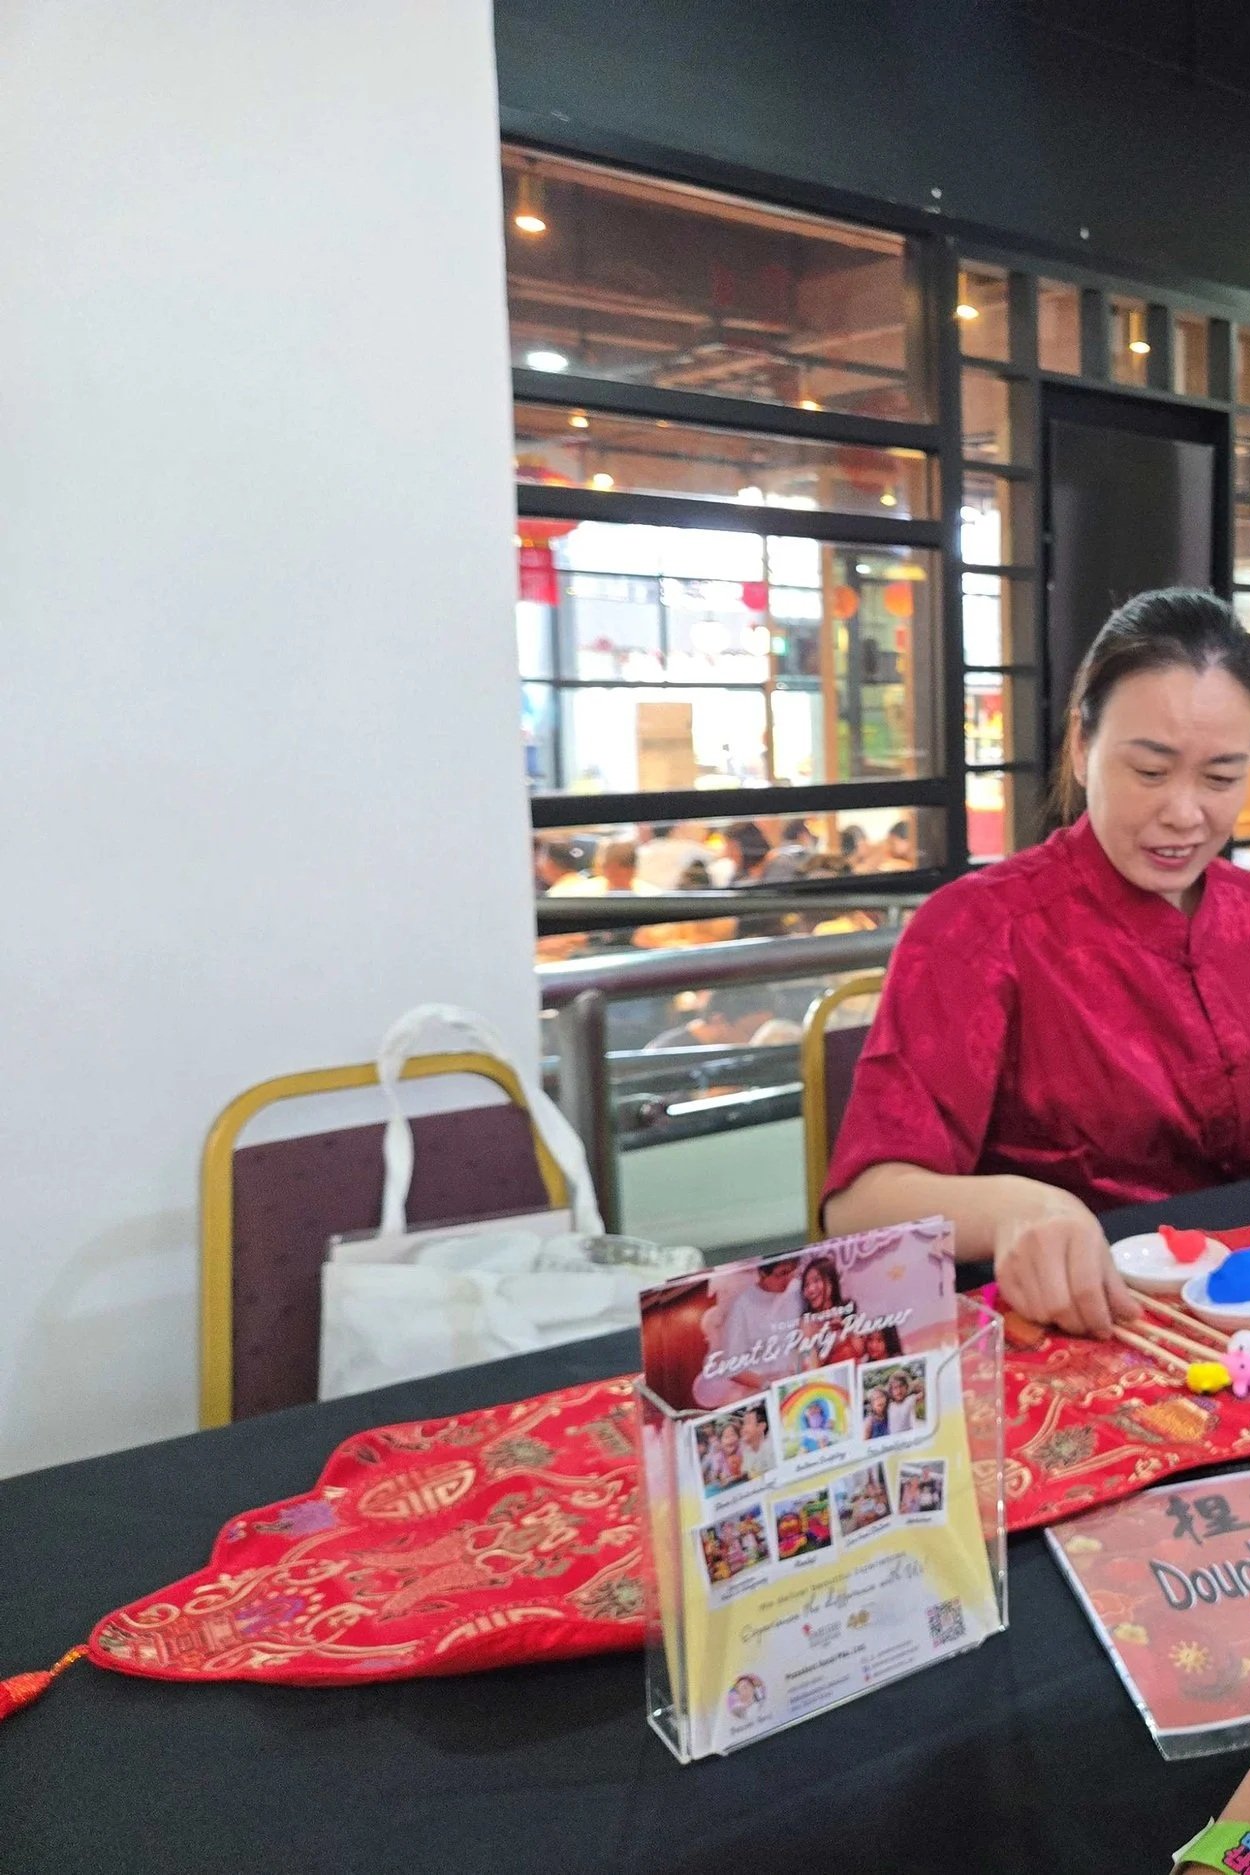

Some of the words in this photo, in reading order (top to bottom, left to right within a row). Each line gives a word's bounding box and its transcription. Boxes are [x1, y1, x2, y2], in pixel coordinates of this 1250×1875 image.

[702, 1342, 764, 1379] Event
[783, 1321, 837, 1360] Party
[839, 1308, 913, 1339] Planner
